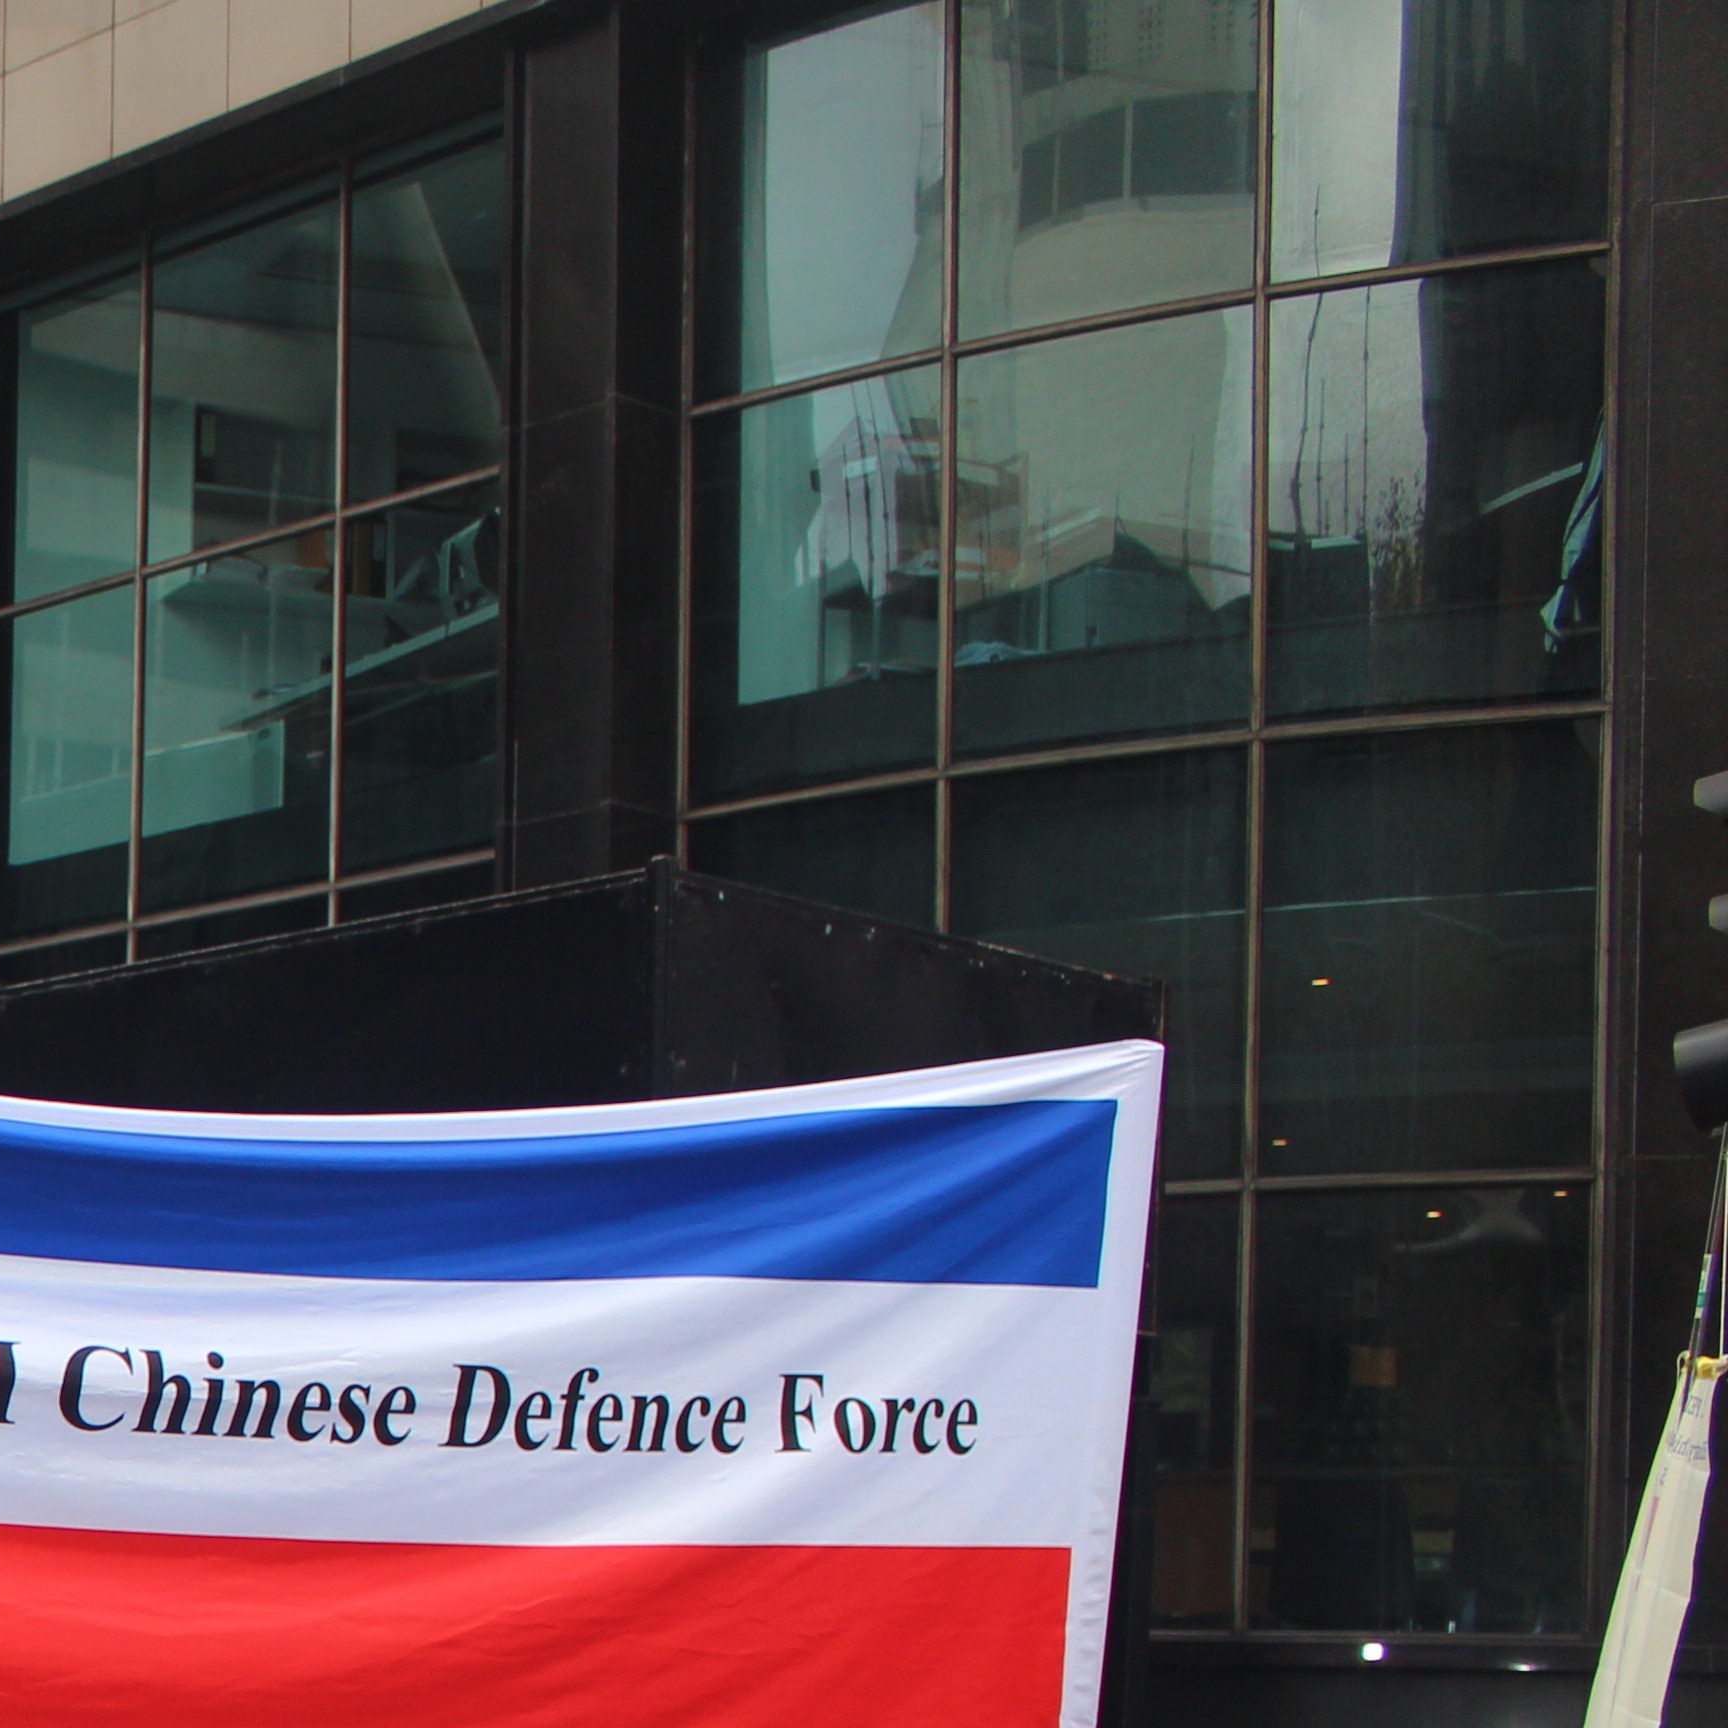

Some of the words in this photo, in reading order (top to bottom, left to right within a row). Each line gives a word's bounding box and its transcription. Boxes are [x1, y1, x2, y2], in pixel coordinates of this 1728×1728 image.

[58, 1346, 417, 1447] Chinese
[438, 1363, 747, 1455] Defence
[773, 1372, 979, 1456] Force
